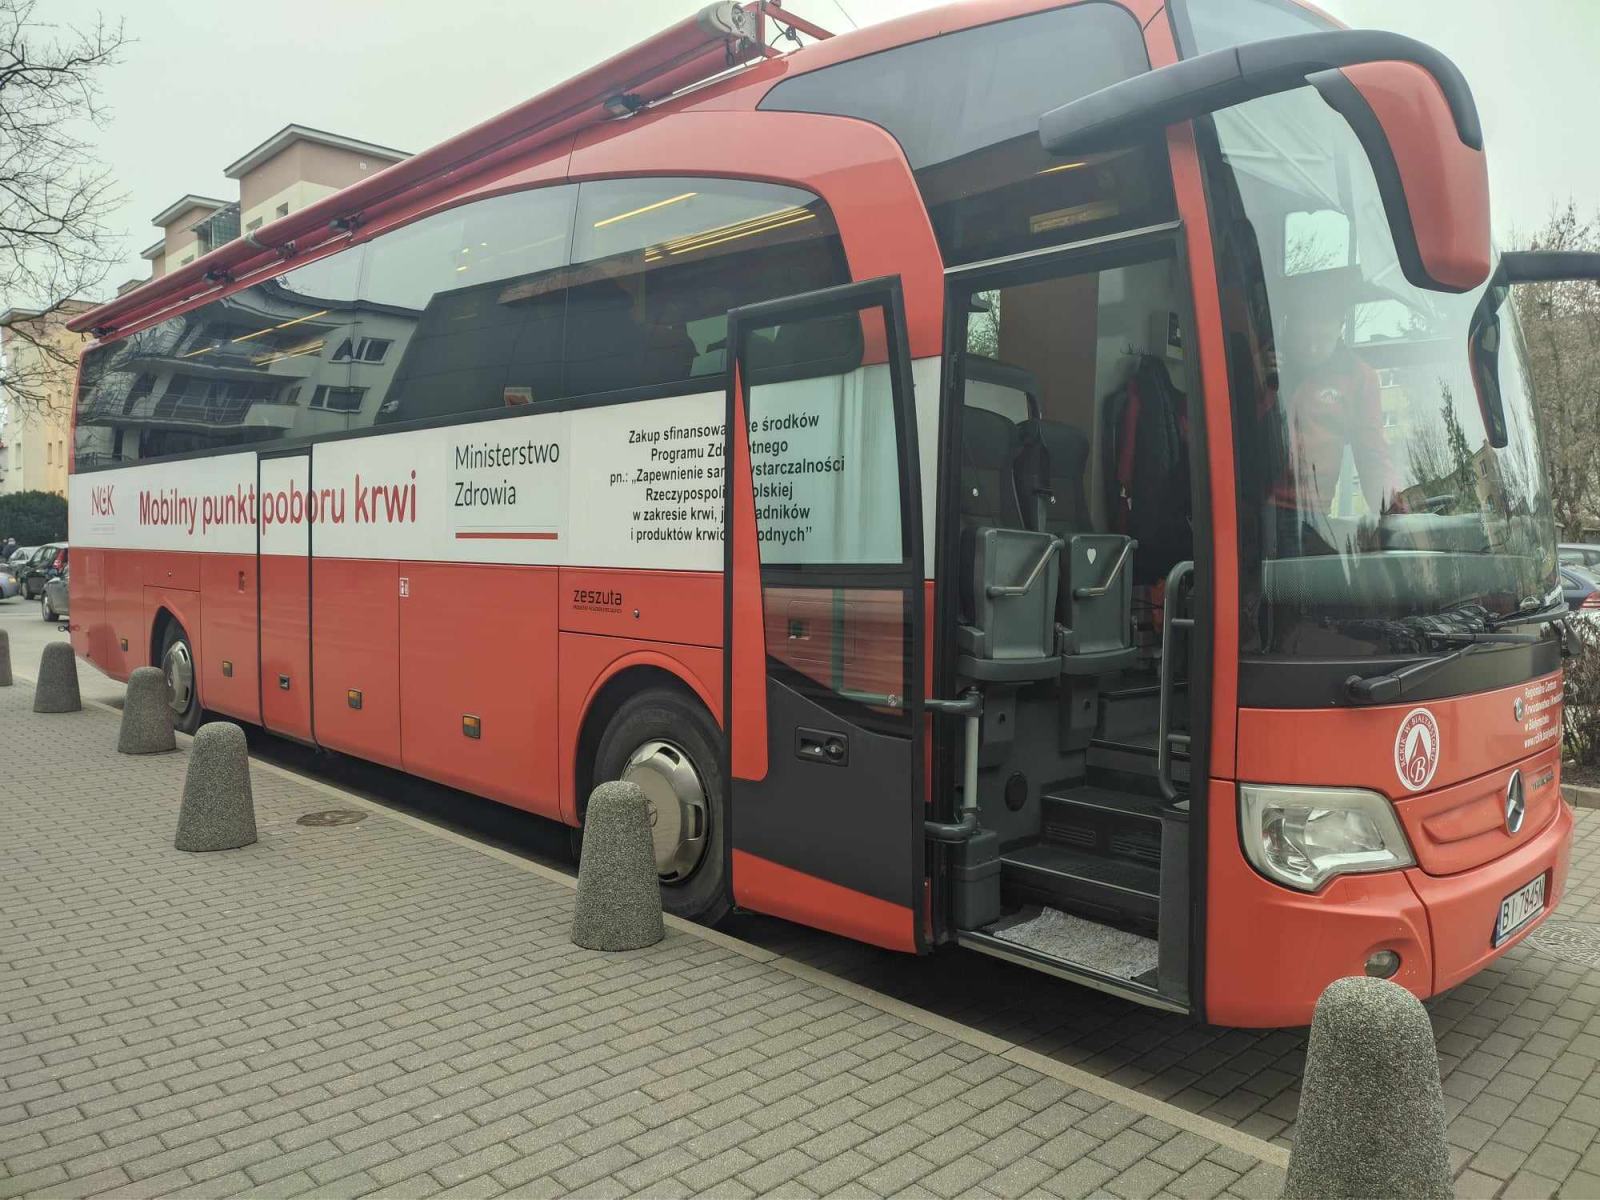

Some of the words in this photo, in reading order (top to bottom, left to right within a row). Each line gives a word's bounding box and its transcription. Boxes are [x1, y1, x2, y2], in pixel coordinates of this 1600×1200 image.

[629, 429, 660, 445] Zakup
[663, 422, 727, 440] sfinansowa
[762, 412, 820, 432] środków
[455, 440, 560, 470] Ministerstwo
[650, 447, 704, 464] Programu
[707, 437, 789, 459] Zdrtnego
[609, 471, 629, 486] pn.:
[631, 465, 704, 484] „Zapewnienie
[707, 455, 846, 479] sastarczalności
[139, 488, 197, 536] Mobilny
[203, 483, 257, 536] punkt
[261, 478, 345, 537] poboru
[354, 470, 417, 524] krwi
[454, 479, 517, 508] Zdrowia
[646, 484, 726, 504] Rzeczypospoli
[752, 480, 793, 501] olskiej
[633, 510, 641, 521] w
[643, 506, 687, 521] zakresie
[690, 506, 718, 523] krwi,
[630, 528, 634, 541] i
[636, 527, 692, 544] produktów
[695, 524, 812, 545] krwioodnych”
[573, 589, 622, 606] zeszuta
[1410, 756, 1426, 783] B
[1503, 898, 1516, 931] BI
